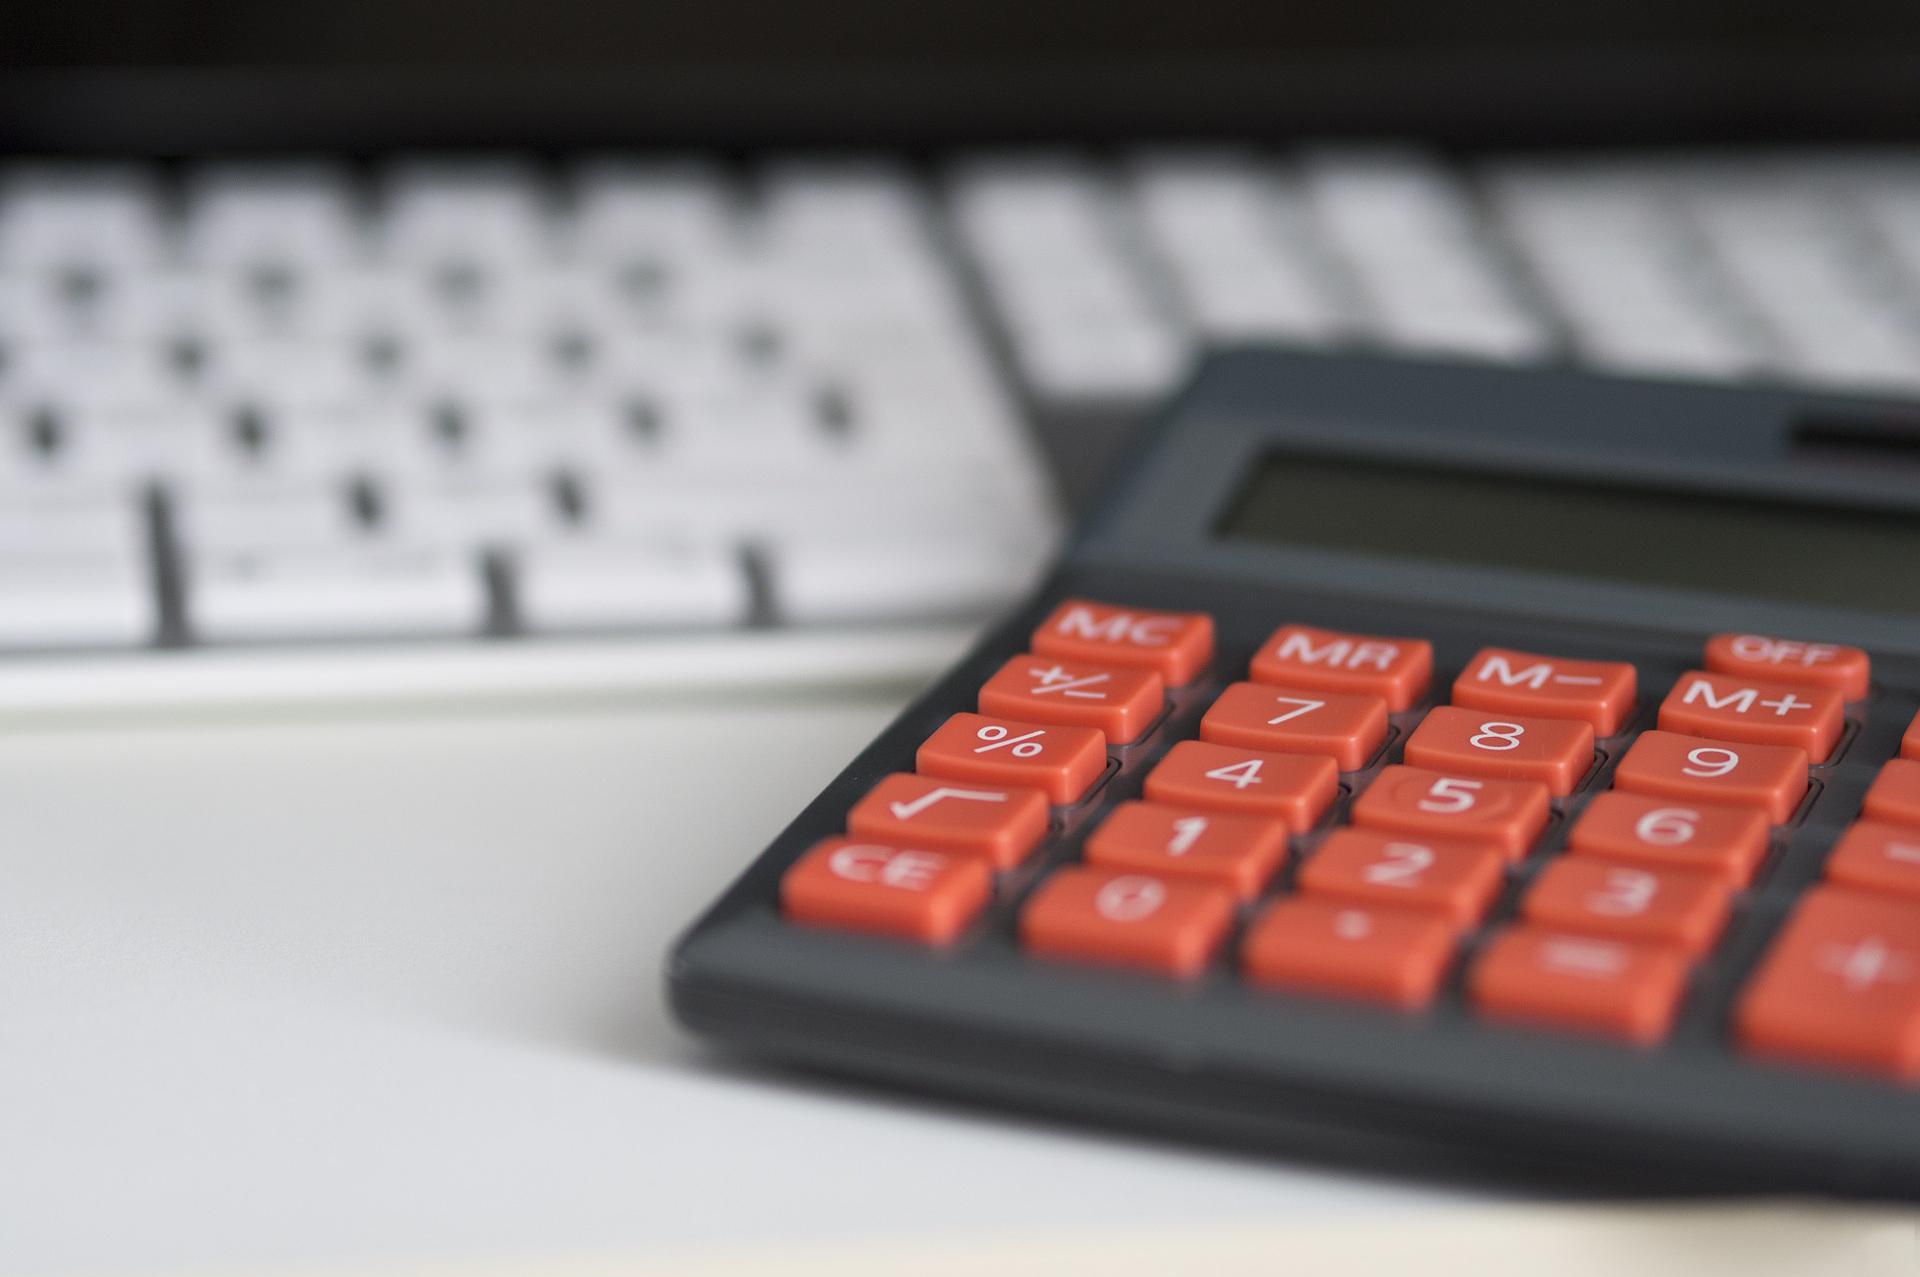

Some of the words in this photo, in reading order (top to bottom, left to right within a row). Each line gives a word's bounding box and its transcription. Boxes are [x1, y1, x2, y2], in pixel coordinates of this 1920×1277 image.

[1056, 607, 1184, 647] MC
[1277, 632, 1399, 672] MR
[1730, 634, 1844, 667] OFF
[1266, 696, 1326, 725] 7
[1682, 679, 1812, 717] M+
[973, 725, 1046, 758] %
[1468, 721, 1525, 752] 8
[1204, 758, 1264, 790] 4
[1681, 747, 1740, 778] 9
[1417, 777, 1484, 814] 5
[1165, 816, 1208, 858] 1
[1635, 808, 1701, 846] 6
[828, 842, 949, 893] CE
[1365, 842, 1436, 888] 2
[1586, 868, 1660, 916] 3
